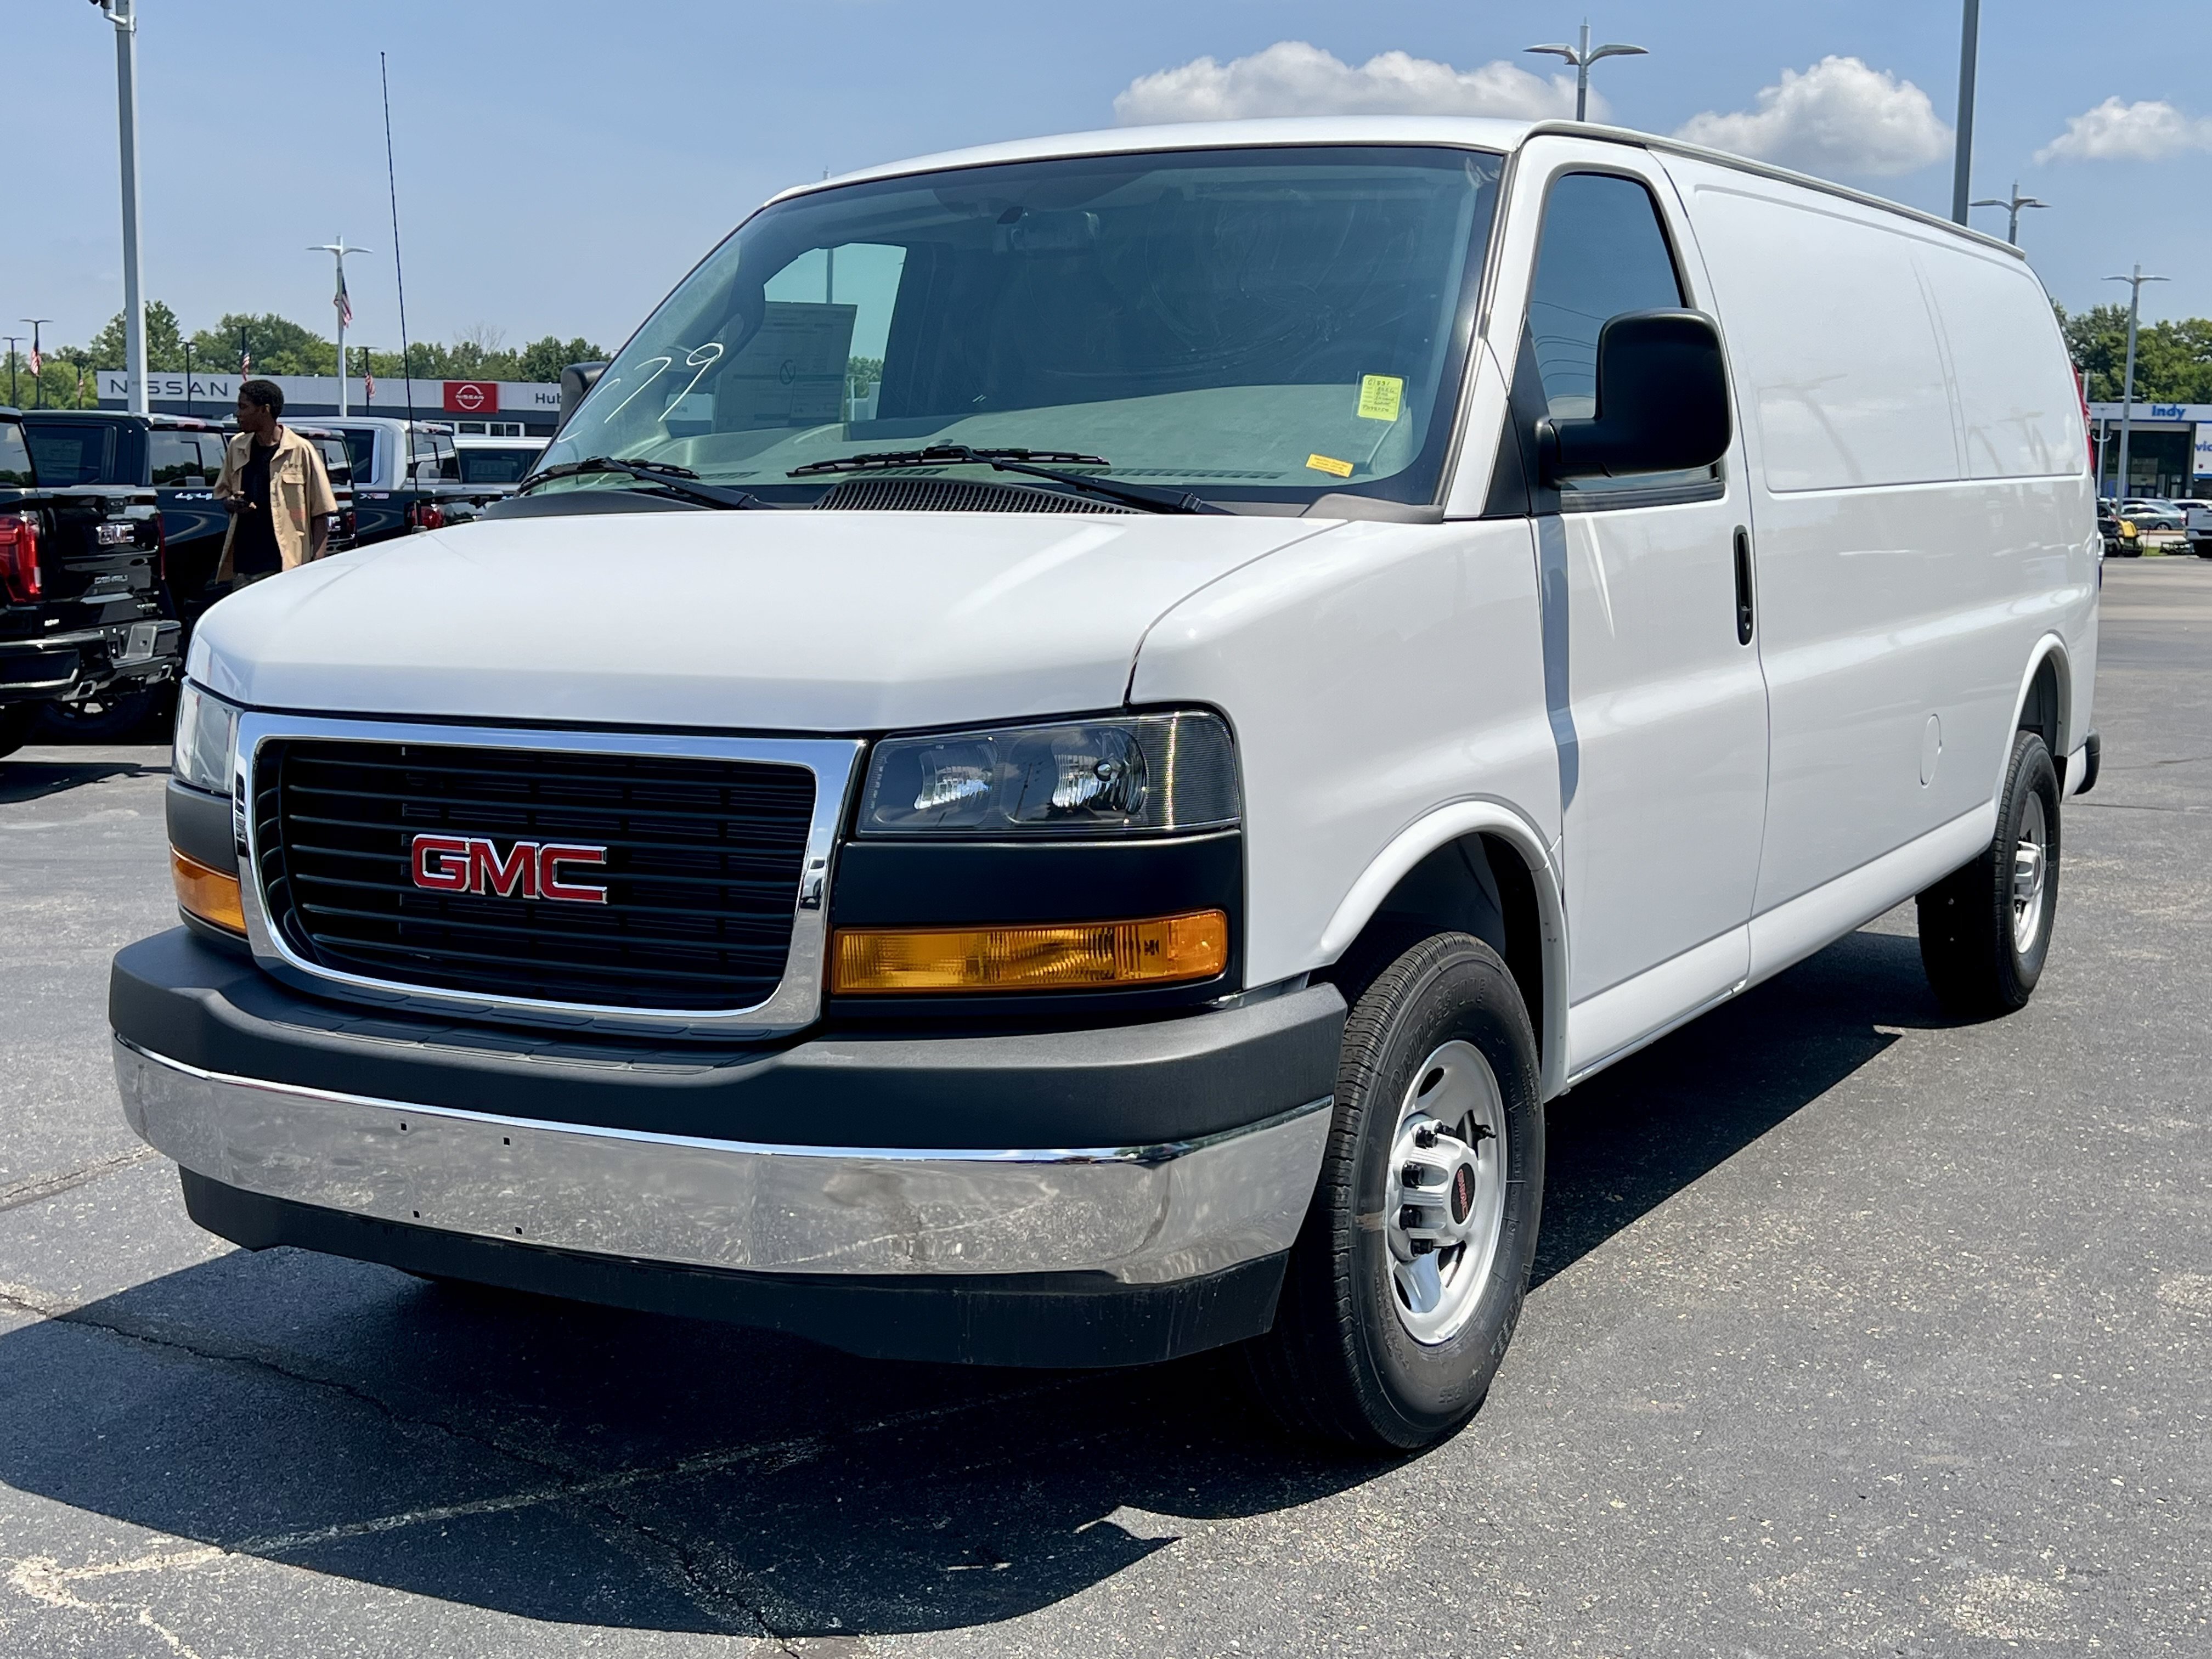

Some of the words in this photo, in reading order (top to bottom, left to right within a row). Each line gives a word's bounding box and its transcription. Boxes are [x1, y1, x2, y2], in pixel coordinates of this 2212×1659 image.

[111, 379, 228, 396] NSSAN
[2152, 404, 2186, 421] Indy
[95, 523, 134, 545] GMC
[411, 833, 608, 905] GMC
[1457, 1168, 1468, 1220] GMC
